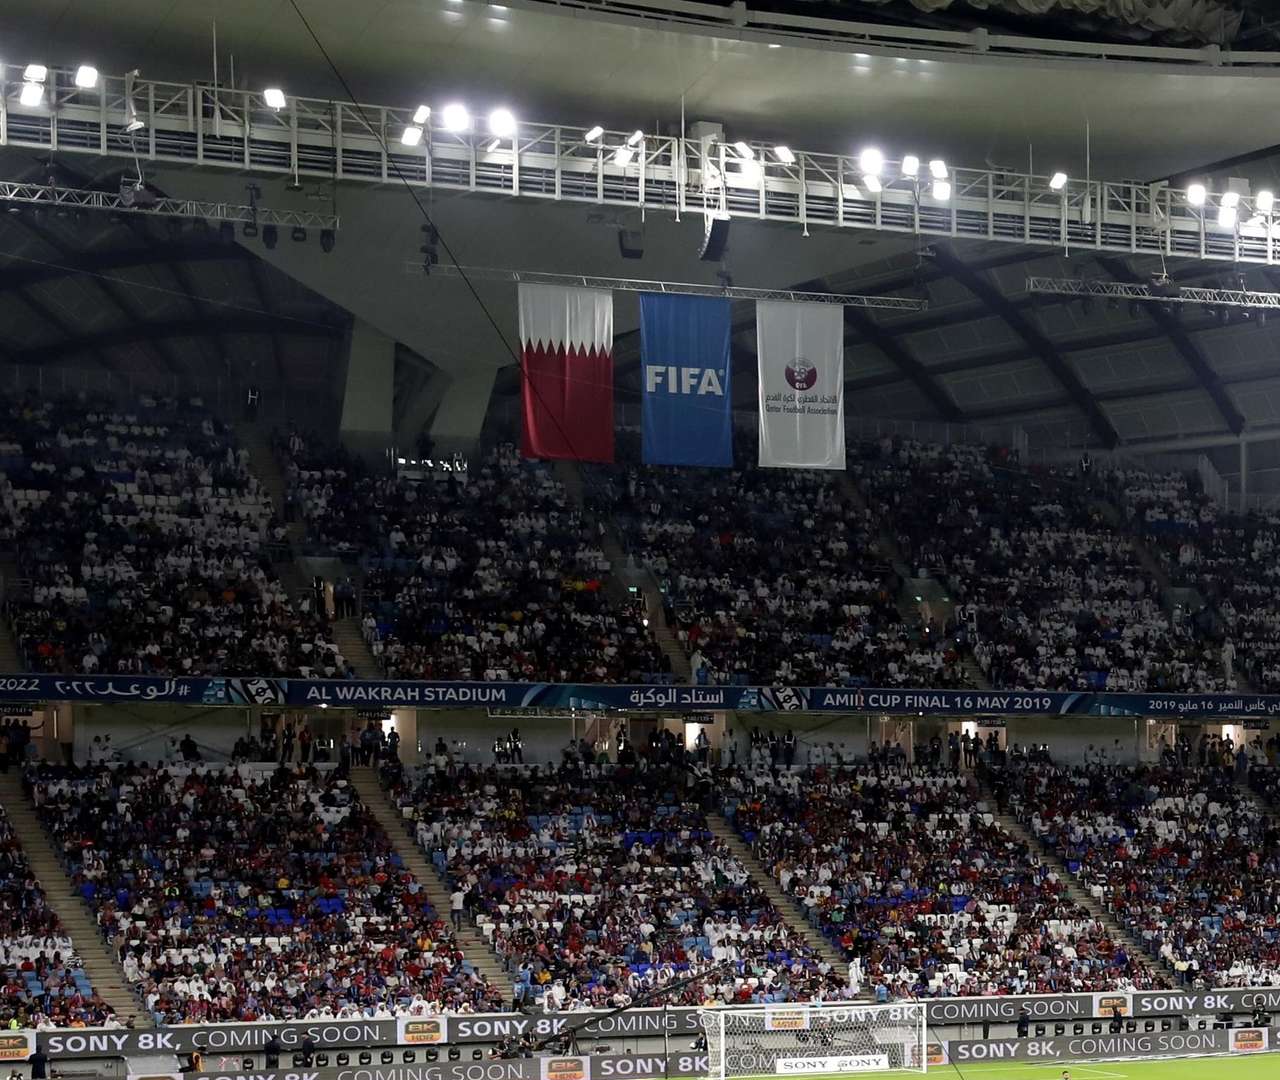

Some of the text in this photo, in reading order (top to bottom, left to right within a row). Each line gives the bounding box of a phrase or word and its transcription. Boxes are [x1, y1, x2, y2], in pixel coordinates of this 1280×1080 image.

[646, 365, 724, 396] FIFA
[306, 688, 506, 702] AL WAKRAH STADIUM
[630, 688, 723, 706] استاد الوكرة
[868, 694, 902, 706] CUP
[905, 696, 950, 708] FINAL
[954, 697, 973, 708] 16
[976, 697, 1011, 709] MAY
[1014, 698, 1052, 710] 2019
[1149, 700, 1176, 710] 2019
[1200, 700, 1214, 710] 16
[1140, 994, 1235, 1010] SONY 8K,
[930, 1002, 1014, 1020] COMING
[458, 1018, 528, 1038] SONY
[48, 1034, 128, 1053] SONY
[138, 1031, 182, 1052] 8K,
[308, 1024, 387, 1044] SOON.
[958, 1034, 1220, 1060] SONY 8K, COMING SOON.
[783, 1060, 828, 1070] SONY
